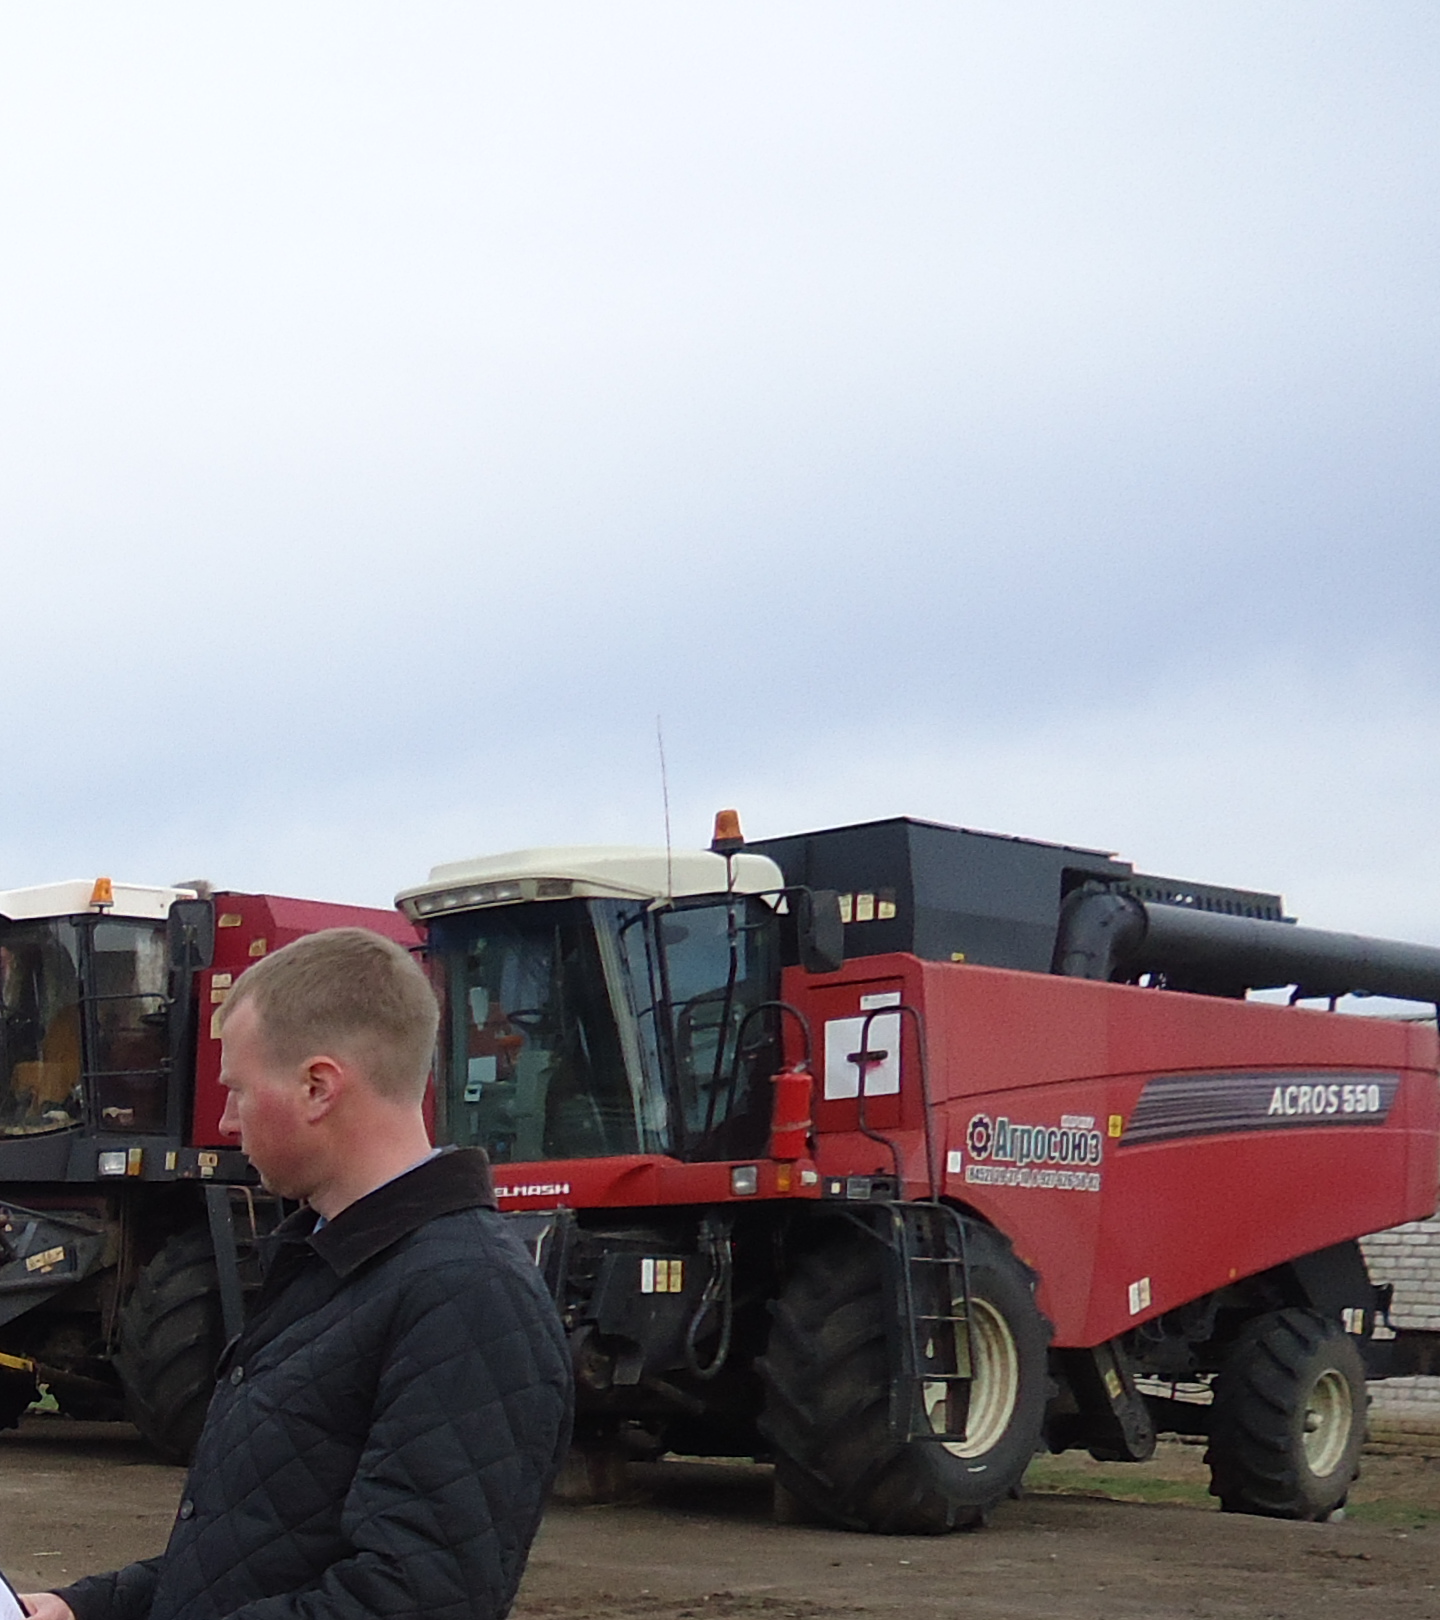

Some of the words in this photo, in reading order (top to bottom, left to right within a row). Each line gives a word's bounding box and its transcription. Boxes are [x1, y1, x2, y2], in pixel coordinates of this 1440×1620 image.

[1269, 1085, 1337, 1115] ACROS
[1342, 1084, 1380, 1112] 550
[994, 1117, 1102, 1166] Агросоюз
